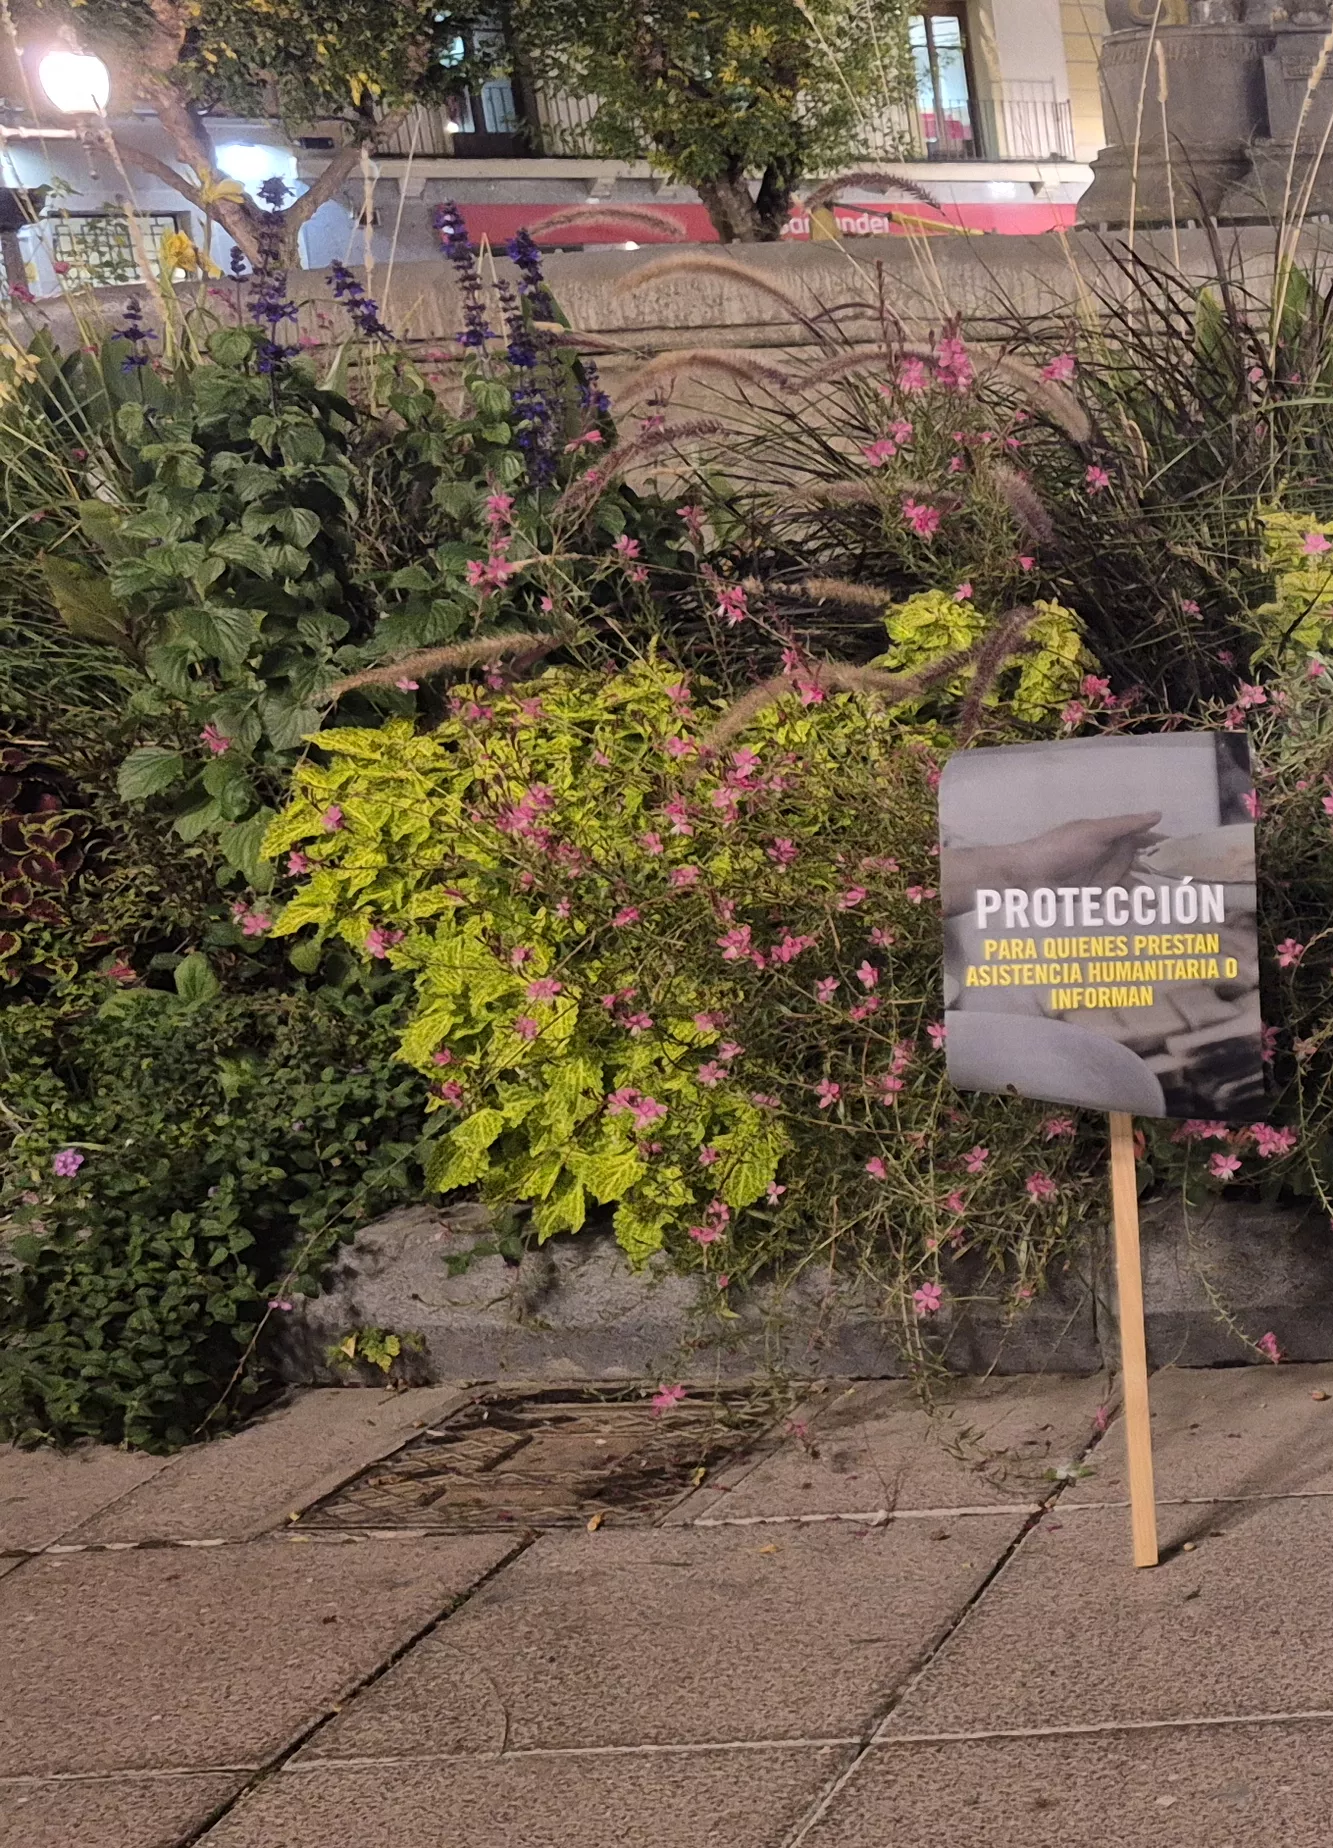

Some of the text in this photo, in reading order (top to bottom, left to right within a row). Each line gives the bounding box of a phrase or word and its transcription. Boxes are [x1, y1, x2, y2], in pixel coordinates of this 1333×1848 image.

[976, 876, 1225, 929] PROTECCIÓN
[984, 933, 1220, 960] PARA QUIENES PRESTAN
[966, 957, 1238, 987] ASISTENCIA HUMANITARIA O
[1051, 985, 1154, 1010] INFORMAN
